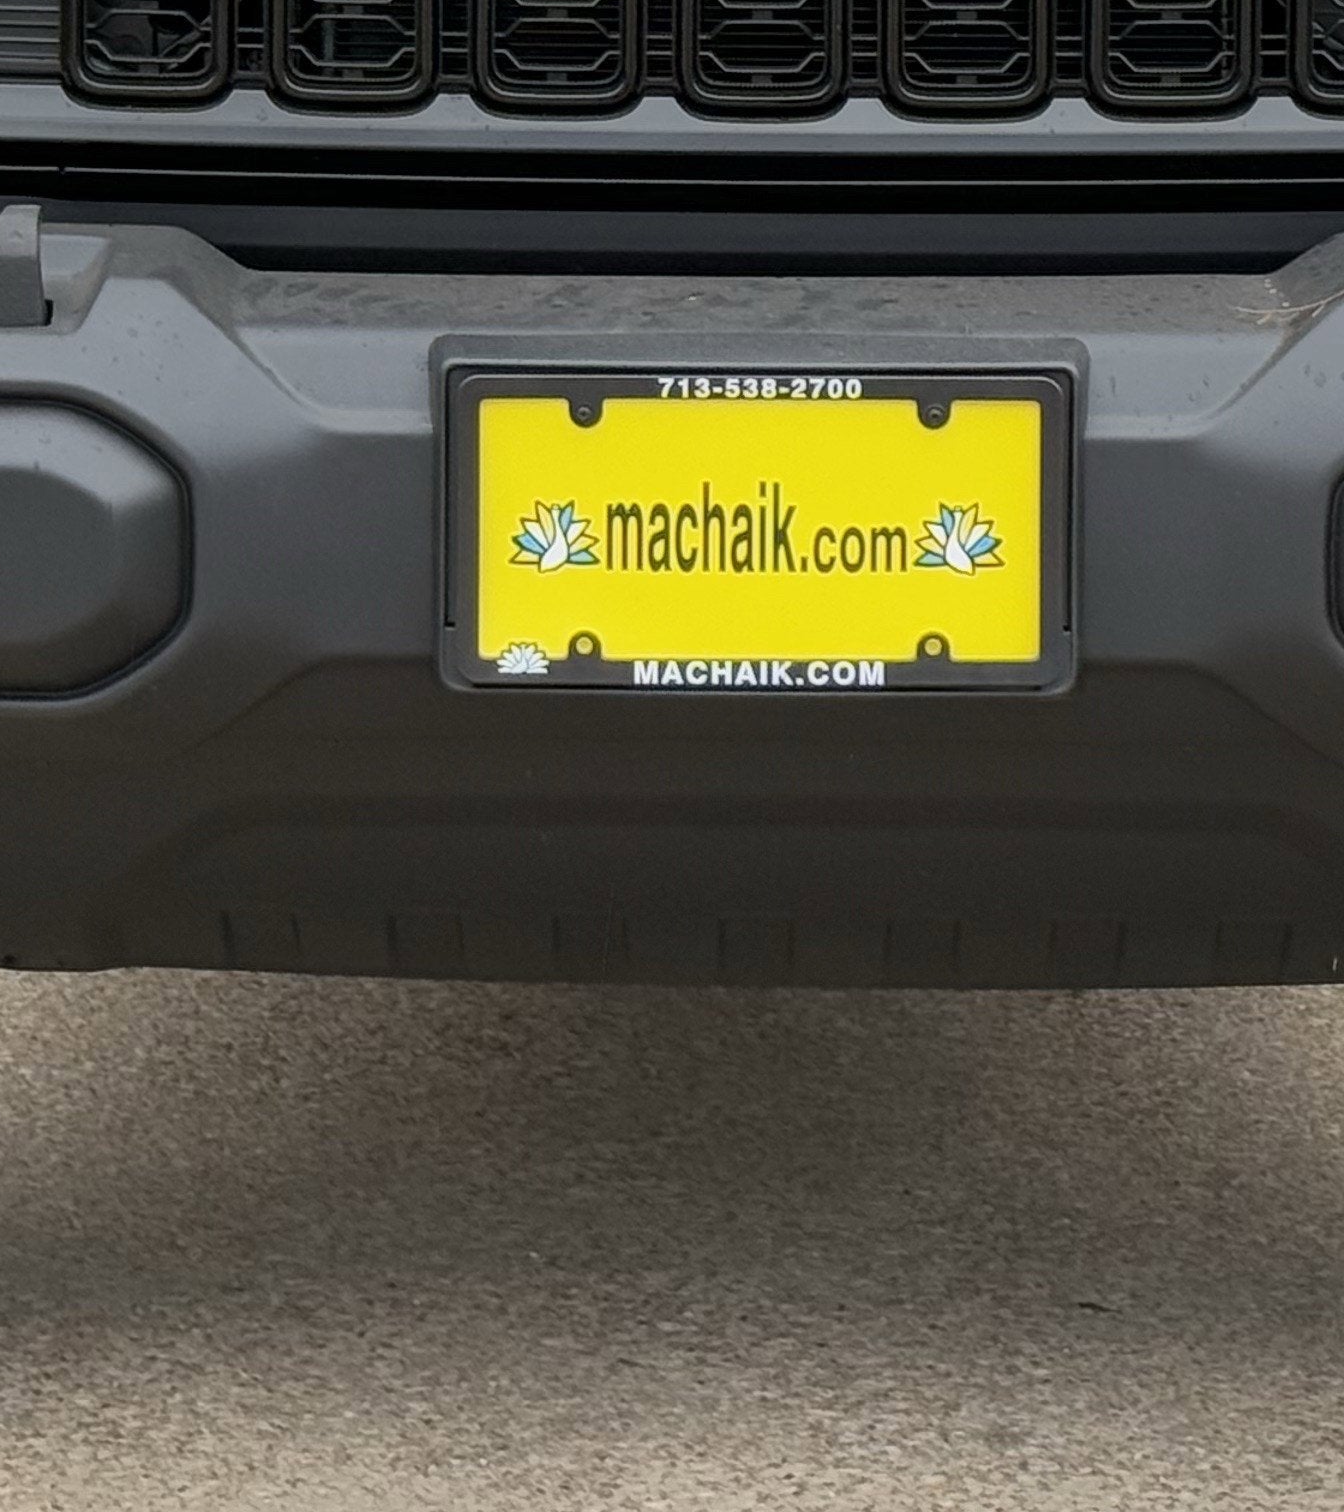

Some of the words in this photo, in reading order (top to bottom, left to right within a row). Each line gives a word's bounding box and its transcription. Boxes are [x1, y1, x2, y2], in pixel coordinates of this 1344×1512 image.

[657, 377, 862, 399] 713-538-2700
[606, 480, 908, 574] machaik.com
[633, 660, 885, 686] MACHAIK.COM
